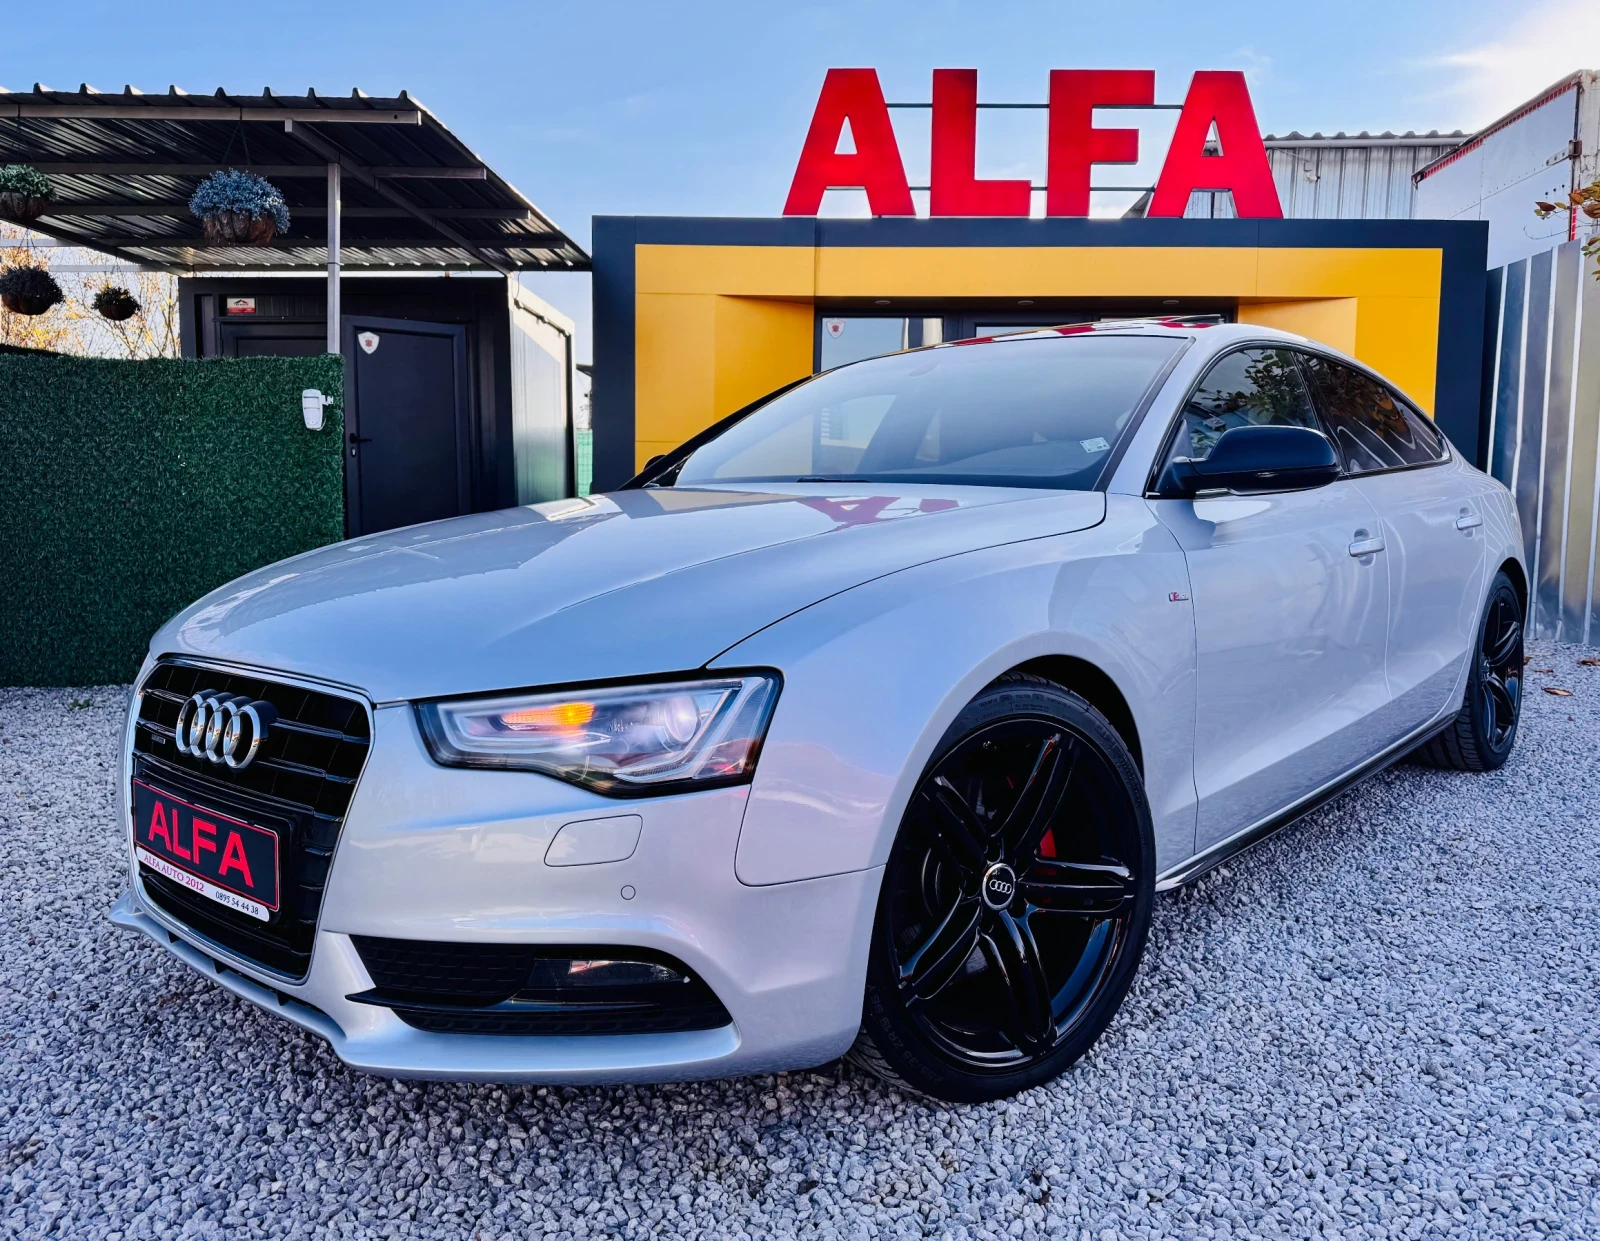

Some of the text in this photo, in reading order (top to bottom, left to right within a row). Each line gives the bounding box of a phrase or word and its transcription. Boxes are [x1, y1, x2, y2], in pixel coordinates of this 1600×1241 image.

[782, 67, 1284, 218] ALFA
[144, 854, 205, 892] ALFA AUTO 2012
[148, 800, 254, 888] ALFA
[215, 891, 259, 915] 0895 54 44 38
